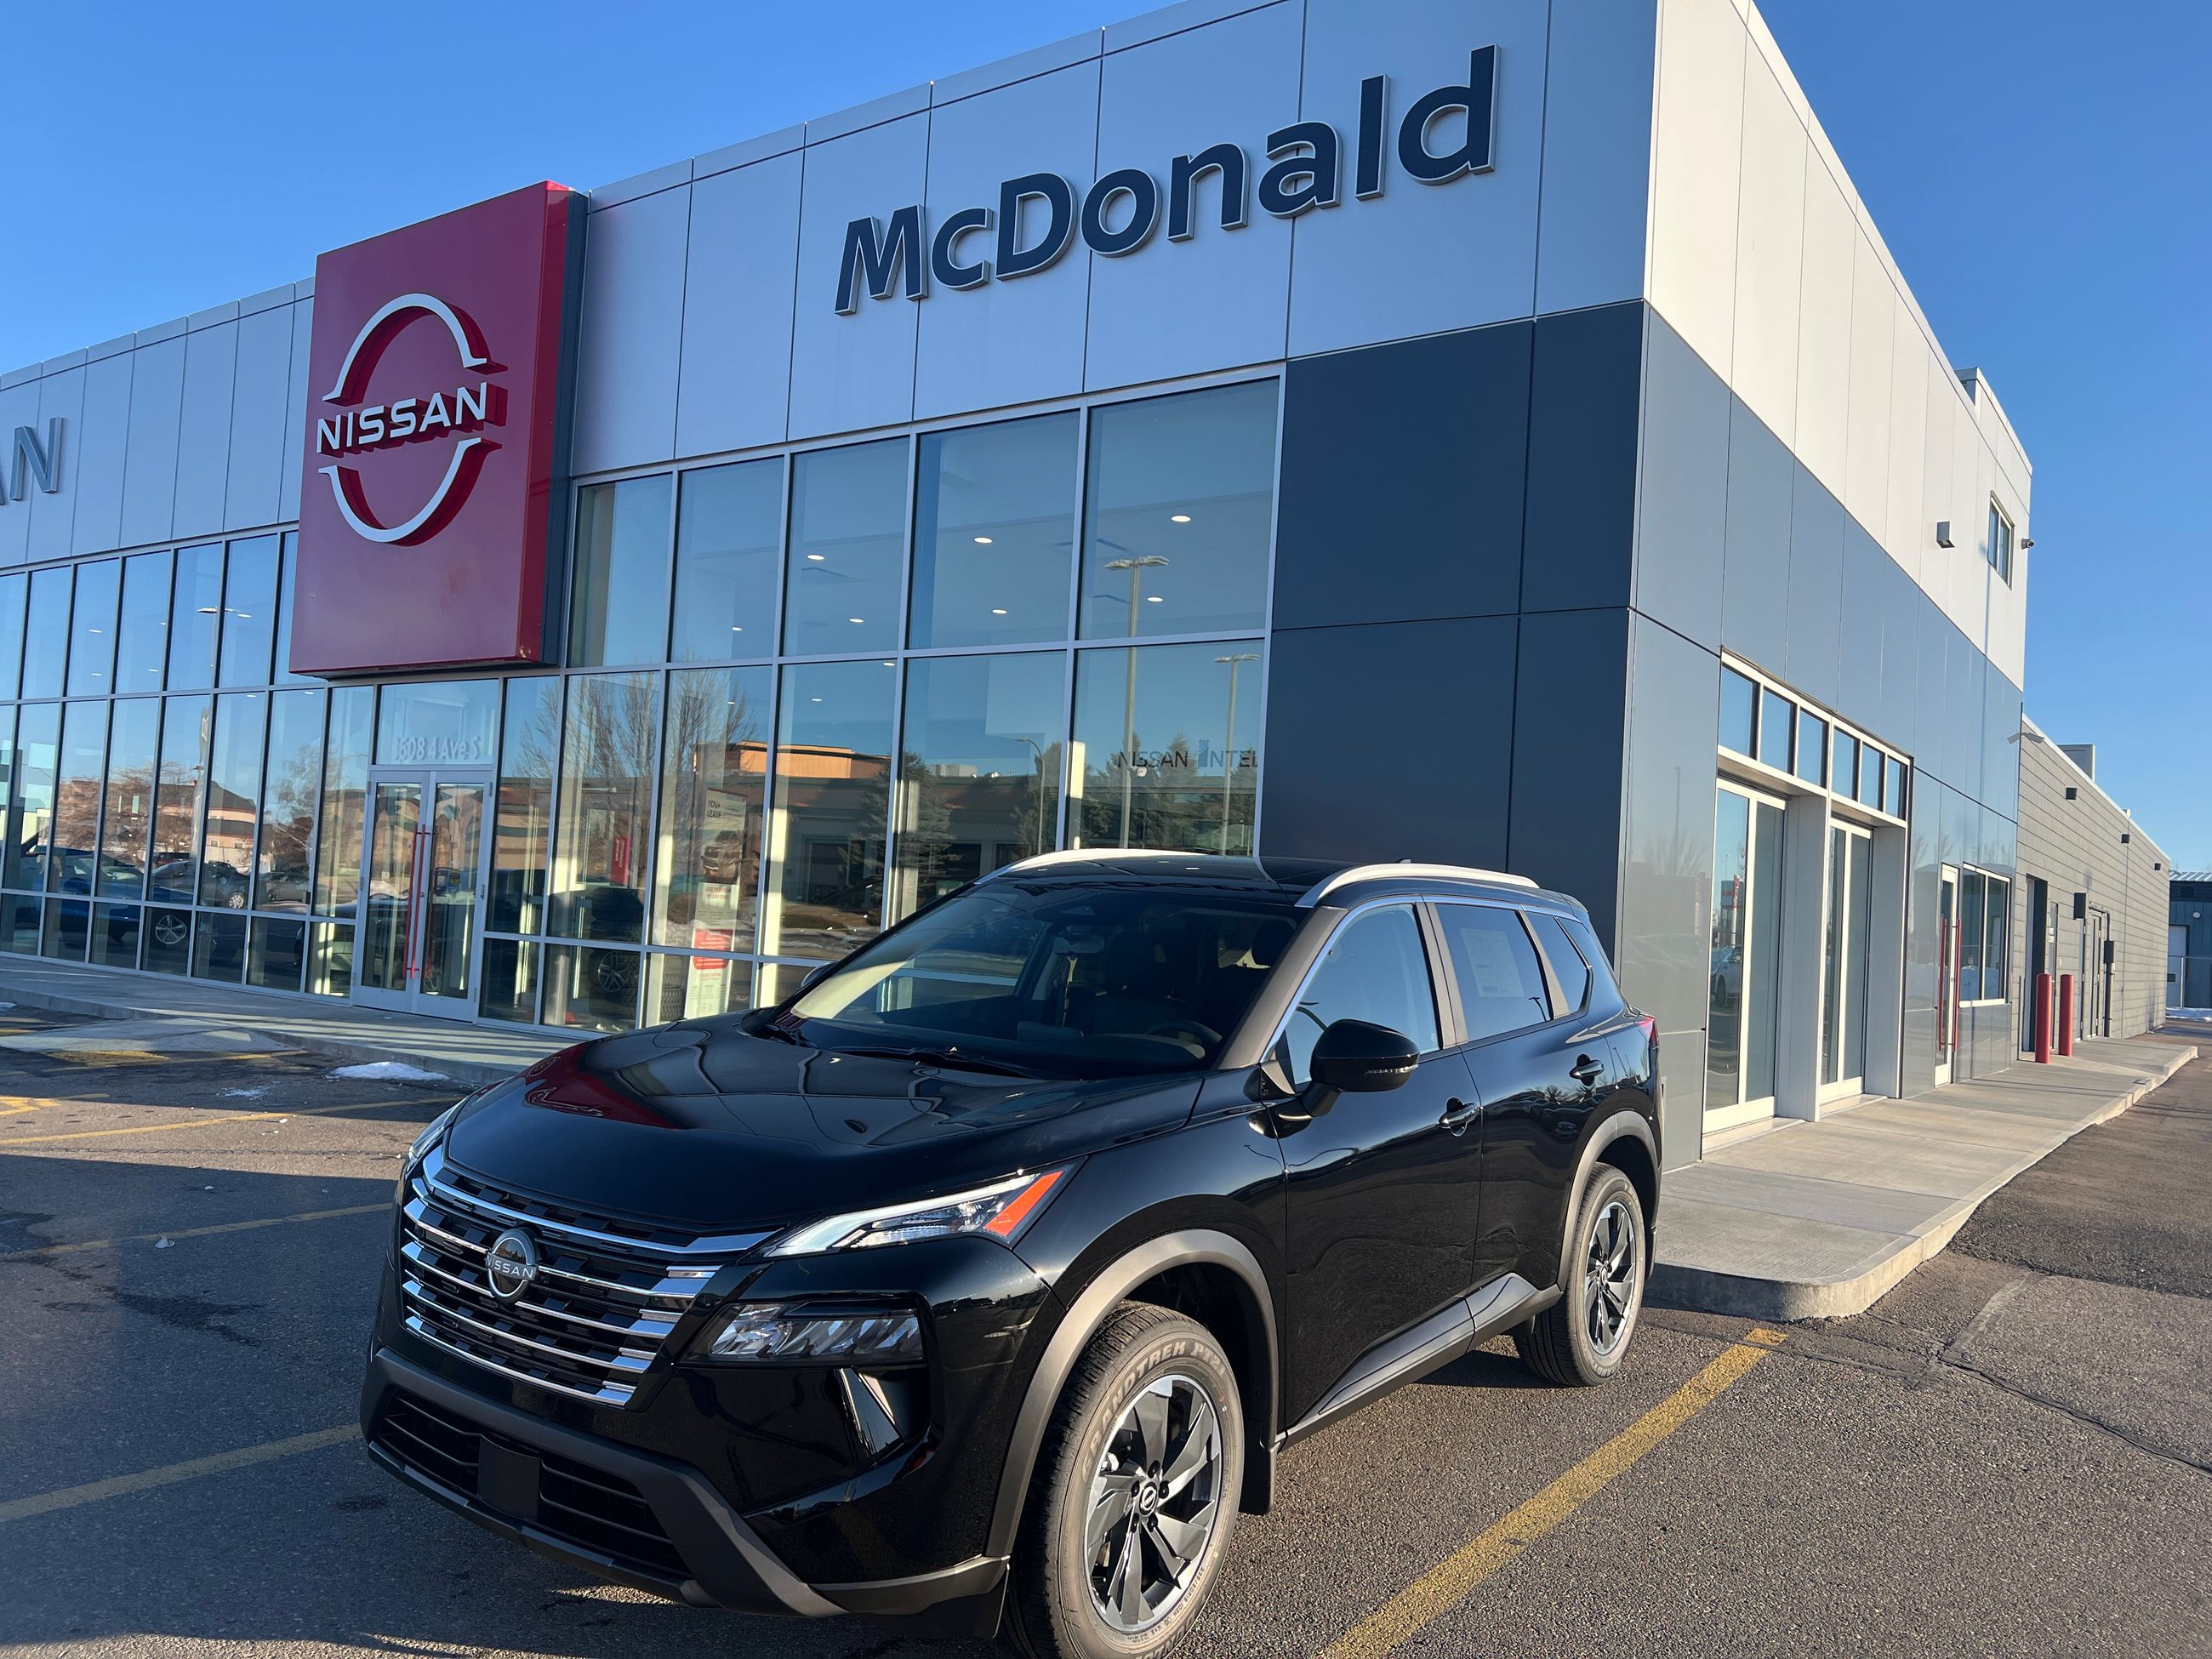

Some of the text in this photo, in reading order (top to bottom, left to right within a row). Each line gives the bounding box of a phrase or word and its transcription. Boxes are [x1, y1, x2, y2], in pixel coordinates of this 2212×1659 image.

[835, 43, 1500, 316] McDonald
[316, 381, 487, 454] NISSAN
[0, 417, 63, 505] N
[1117, 750, 1189, 768] NISSAN
[485, 1253, 534, 1279] NISSAN
